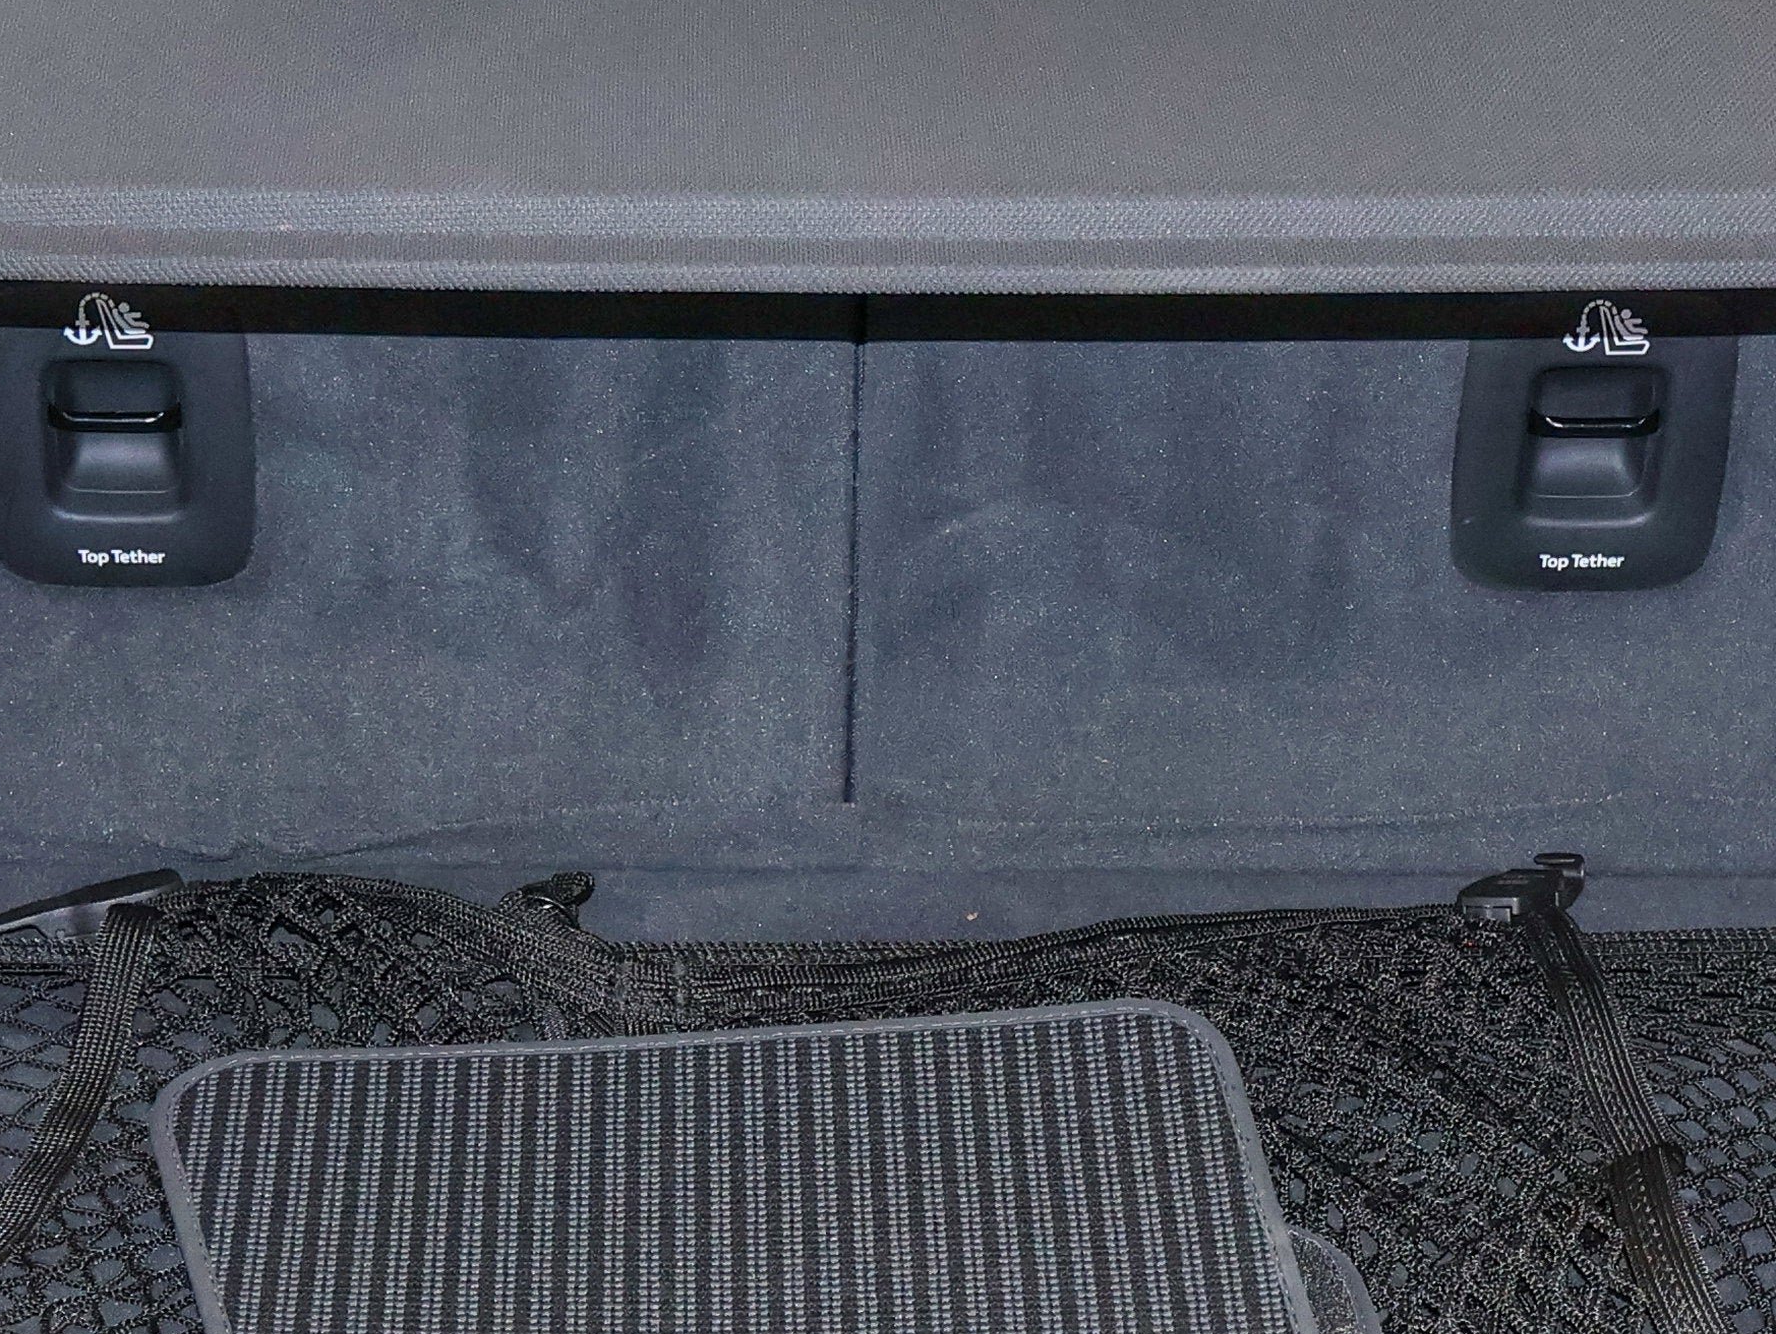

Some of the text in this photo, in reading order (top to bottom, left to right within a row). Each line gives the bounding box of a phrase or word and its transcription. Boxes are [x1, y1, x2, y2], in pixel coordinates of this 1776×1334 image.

[77, 549, 166, 567] Top Tether
[1539, 553, 1625, 571] Top Tether
